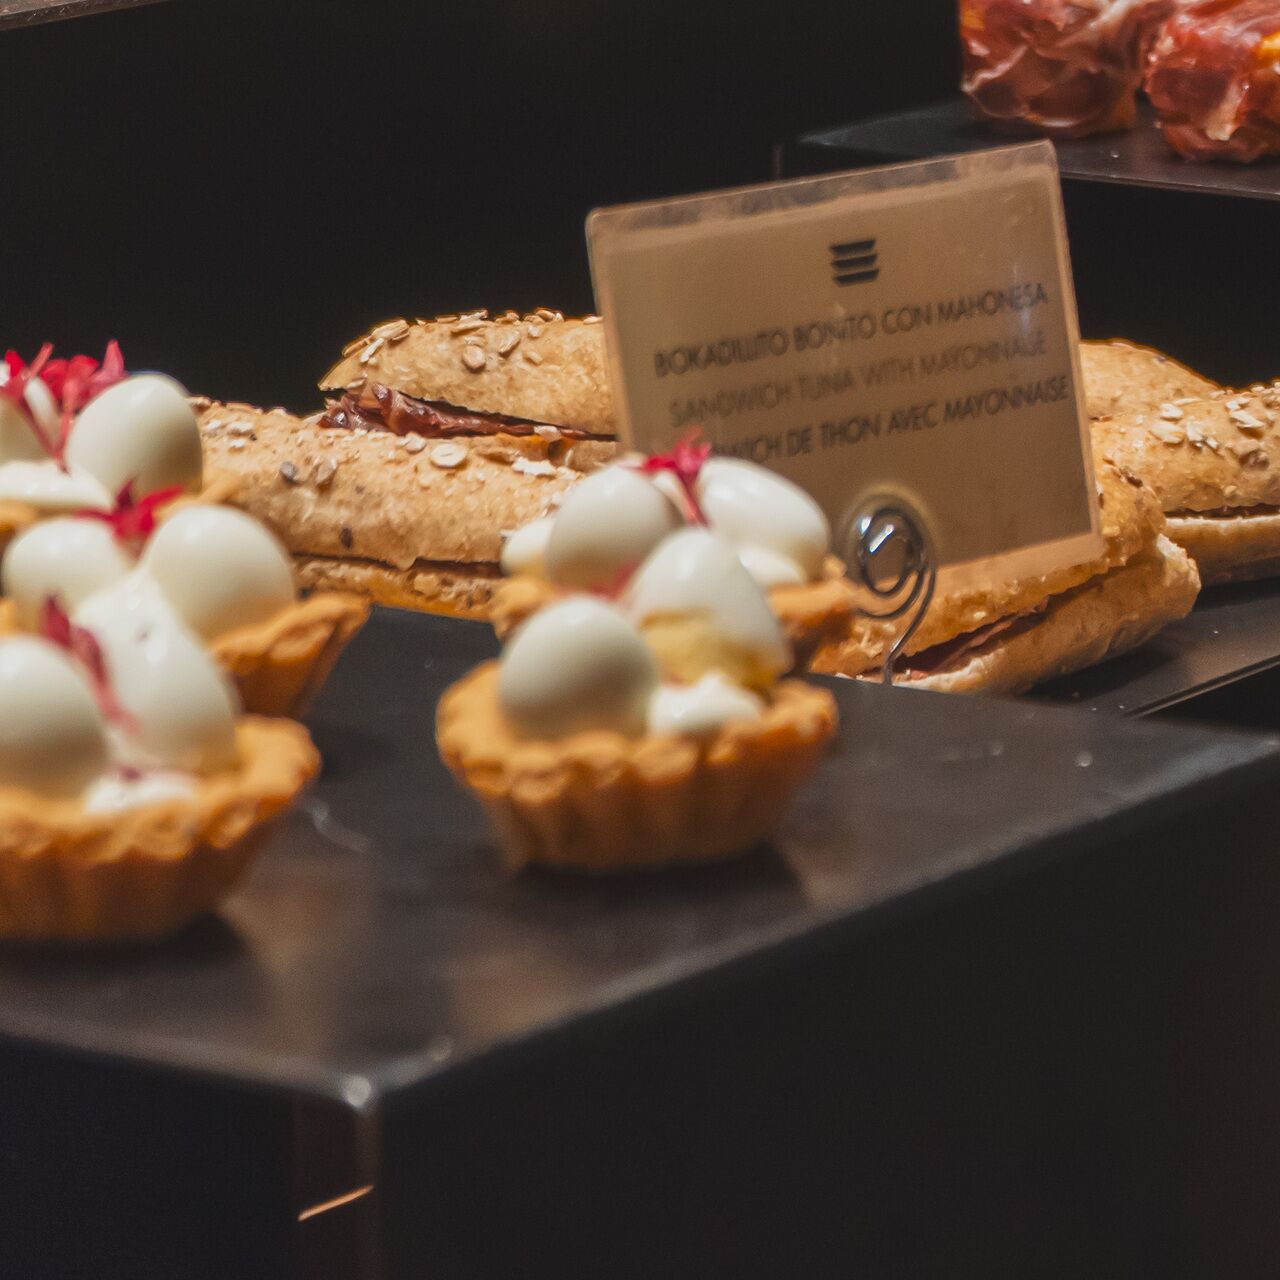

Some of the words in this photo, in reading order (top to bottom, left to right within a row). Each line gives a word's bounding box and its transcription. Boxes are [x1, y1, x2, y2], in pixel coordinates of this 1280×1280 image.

[793, 314, 876, 352] BONITO
[881, 301, 932, 335] CON
[936, 281, 1048, 323] MAHONESA
[670, 379, 793, 429] SANDWICH
[798, 368, 856, 403] TUNA
[864, 355, 915, 389] WITH
[786, 425, 813, 458] DE
[820, 412, 881, 448] THON
[887, 401, 940, 434] AVEC
[942, 373, 1069, 424] MAYONNAISE
